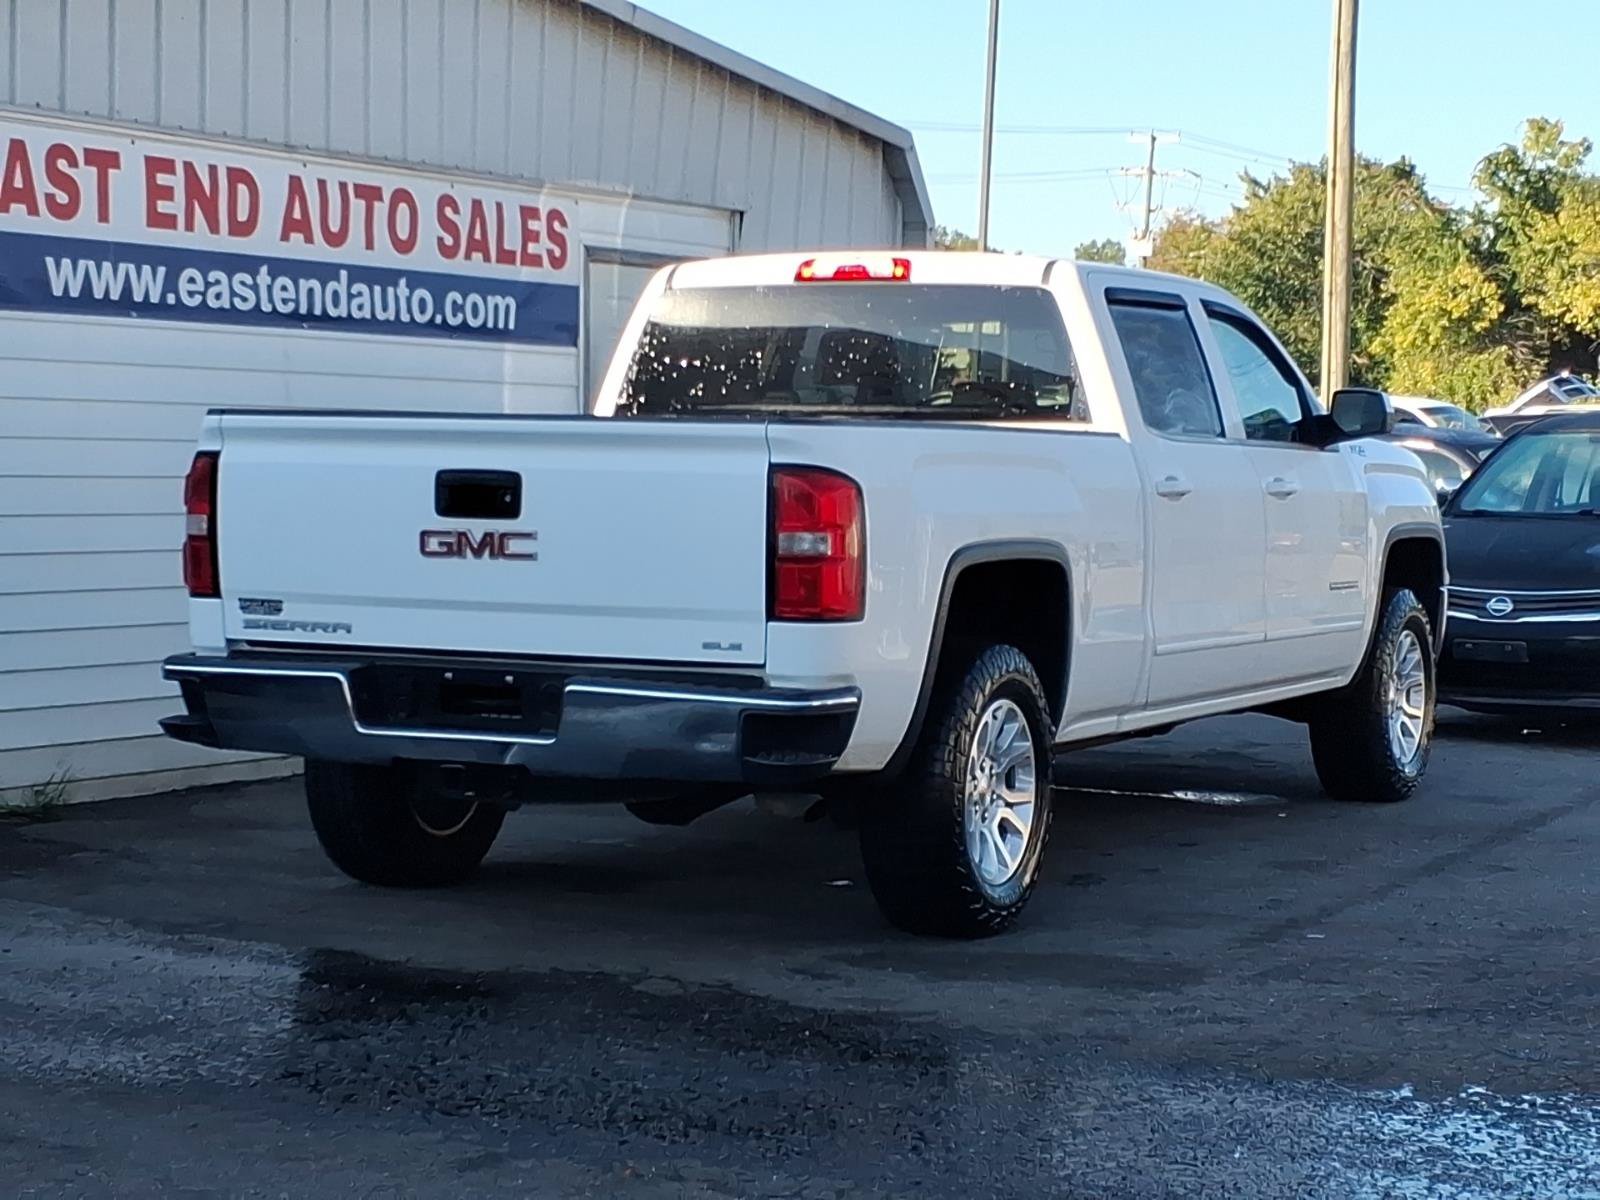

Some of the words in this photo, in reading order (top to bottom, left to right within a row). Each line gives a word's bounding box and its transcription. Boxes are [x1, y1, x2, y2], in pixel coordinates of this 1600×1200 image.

[0, 138, 121, 223] AST
[144, 155, 260, 238] END
[280, 174, 419, 255] AUTO
[436, 193, 569, 270] SALES
[45, 256, 517, 330] www.eastendauto.com
[419, 528, 538, 561] GMC
[243, 618, 352, 634] SIERRA
